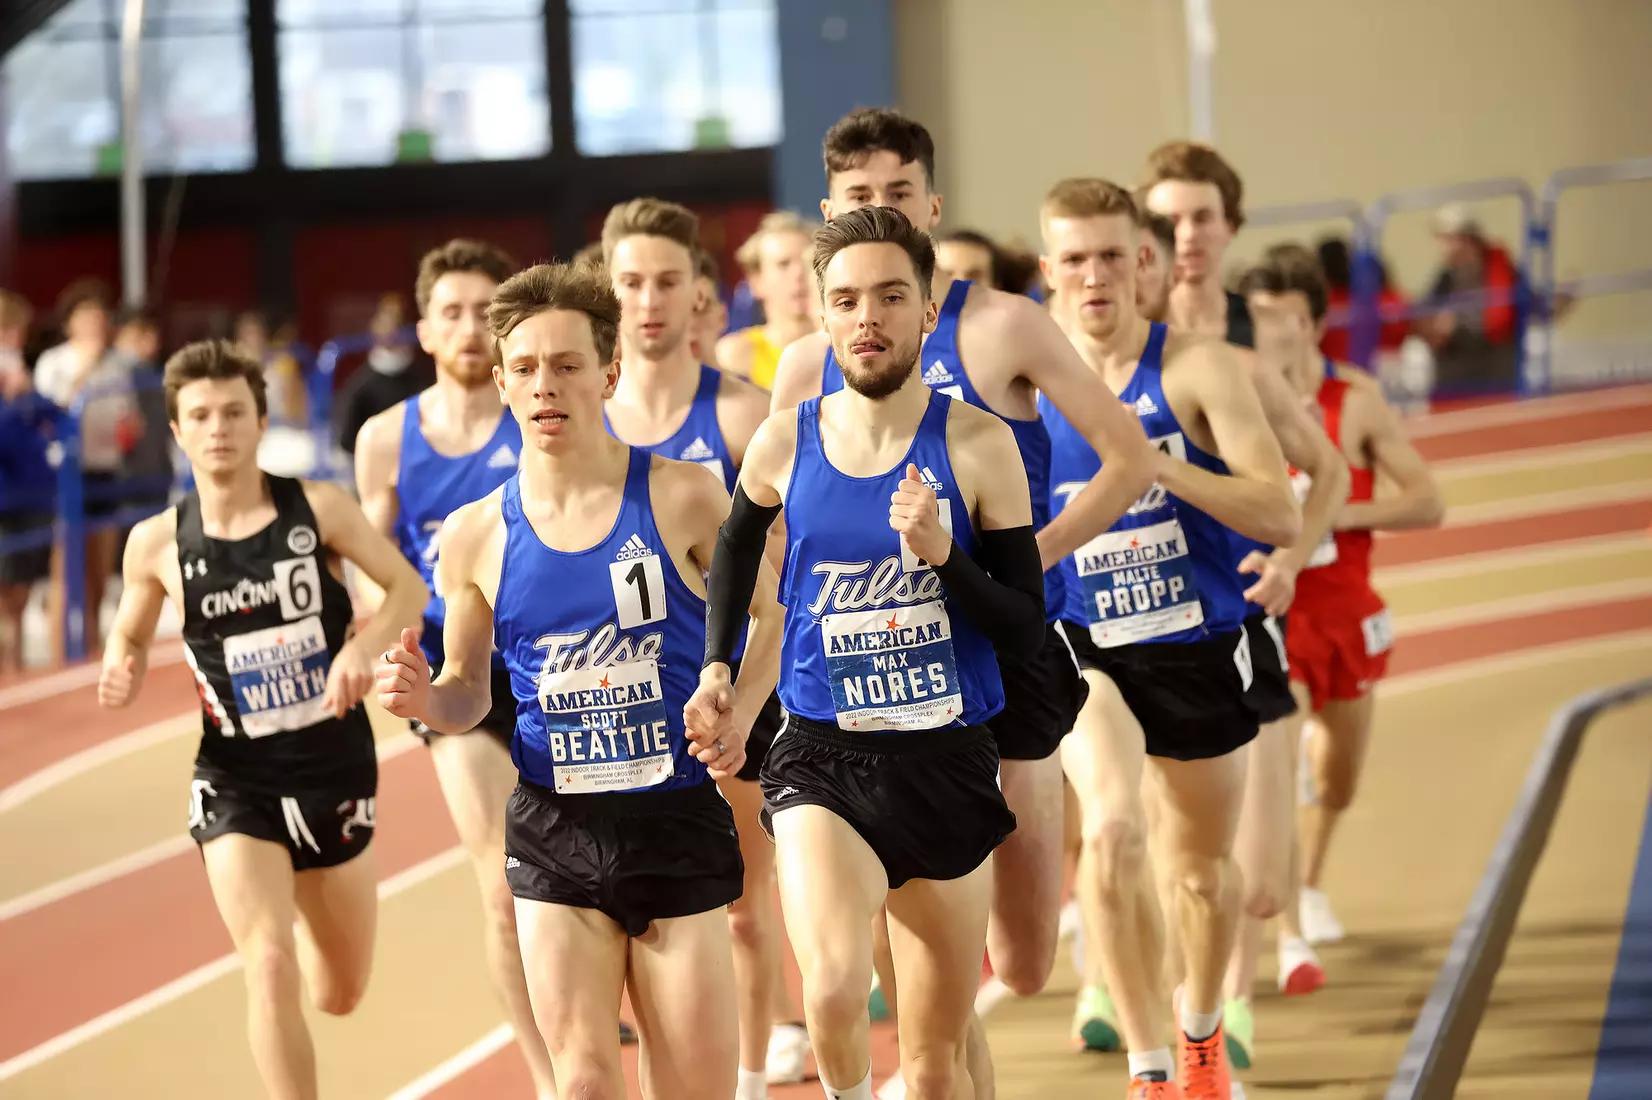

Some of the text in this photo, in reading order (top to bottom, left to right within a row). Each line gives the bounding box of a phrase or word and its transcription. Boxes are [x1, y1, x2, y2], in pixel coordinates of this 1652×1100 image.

[616, 547, 653, 561] adidas
[1083, 540, 1179, 573] AMERICAN
[288, 563, 312, 611] 6
[624, 562, 652, 621] 1
[806, 555, 945, 616] Tulsa
[1112, 565, 1161, 587] MALTE
[1094, 575, 1185, 619] PROPP
[830, 621, 944, 654] AMERICAN
[872, 652, 909, 673] MAX
[242, 667, 326, 711] WIRTH
[546, 681, 655, 711] AMERICAN
[843, 662, 948, 706] NORES
[581, 710, 628, 729] SCOTT
[549, 720, 670, 762] BEATTIE
